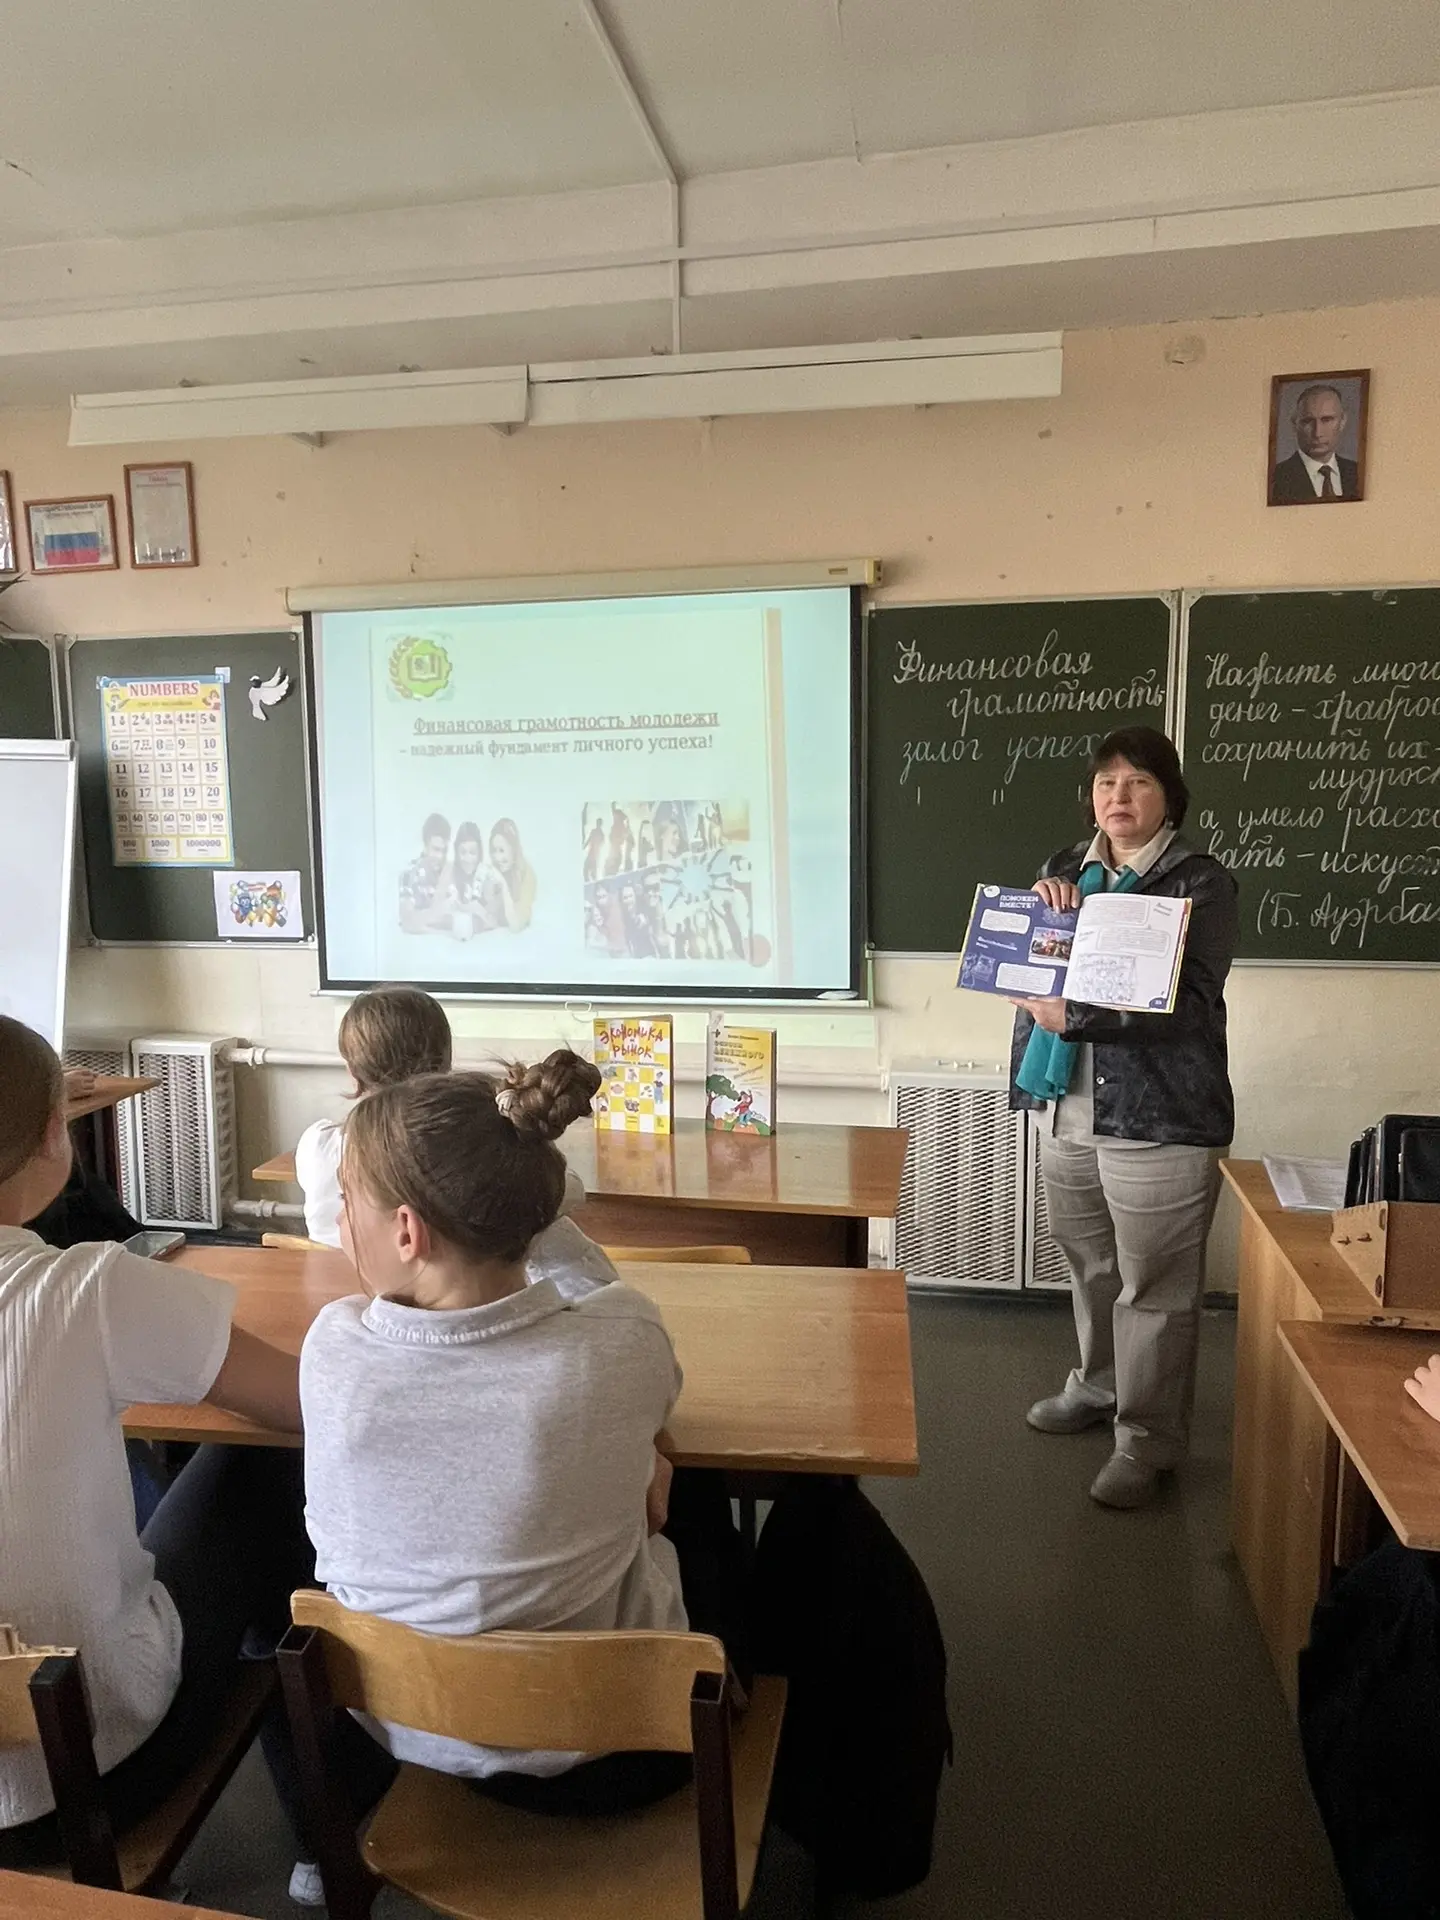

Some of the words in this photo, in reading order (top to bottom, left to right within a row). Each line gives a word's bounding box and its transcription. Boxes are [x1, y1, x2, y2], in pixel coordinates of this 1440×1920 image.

[893, 629, 1093, 683] Финансовая
[1204, 652, 1337, 699] Нажить
[129, 682, 199, 697] NUMBERS
[111, 715, 116, 726] 1
[132, 715, 140, 726] 2
[154, 714, 162, 725] 3
[178, 714, 184, 724] 4
[200, 713, 208, 724] 5
[413, 717, 512, 735] Финансовая
[518, 715, 625, 736] грамотность
[630, 712, 719, 729] молодежи
[1209, 701, 1281, 738] денег
[111, 740, 119, 751] 6
[133, 740, 140, 750] 7
[156, 739, 164, 750] 8
[178, 738, 186, 750] 9
[204, 738, 216, 749] 10
[410, 740, 484, 757] надежный
[488, 739, 568, 758] фундамент
[574, 737, 644, 753] личного
[648, 734, 713, 754] успеха!
[1202, 728, 1372, 782] сохранить
[1388, 740, 1430, 759] их
[115, 764, 127, 774] 11
[138, 764, 149, 774] 12
[160, 763, 172, 773] 13
[182, 763, 194, 773] 14
[205, 762, 218, 773] 15
[900, 738, 983, 785] залог
[1006, 732, 1111, 784] успех
[116, 788, 128, 798] 16
[139, 788, 151, 798] 17
[162, 788, 174, 798] 18
[184, 787, 196, 798] 19
[207, 786, 220, 797] 20
[148, 813, 159, 822] 50
[163, 813, 175, 822] 60
[180, 813, 191, 822] 70
[212, 813, 224, 822] 90
[1200, 809, 1219, 829] а
[1237, 807, 1324, 844] умело
[1310, 887, 1440, 948] Ауэрба
[600, 1023, 664, 1044] ЭКОНОМИКА
[612, 1043, 652, 1059] РЫНОК
